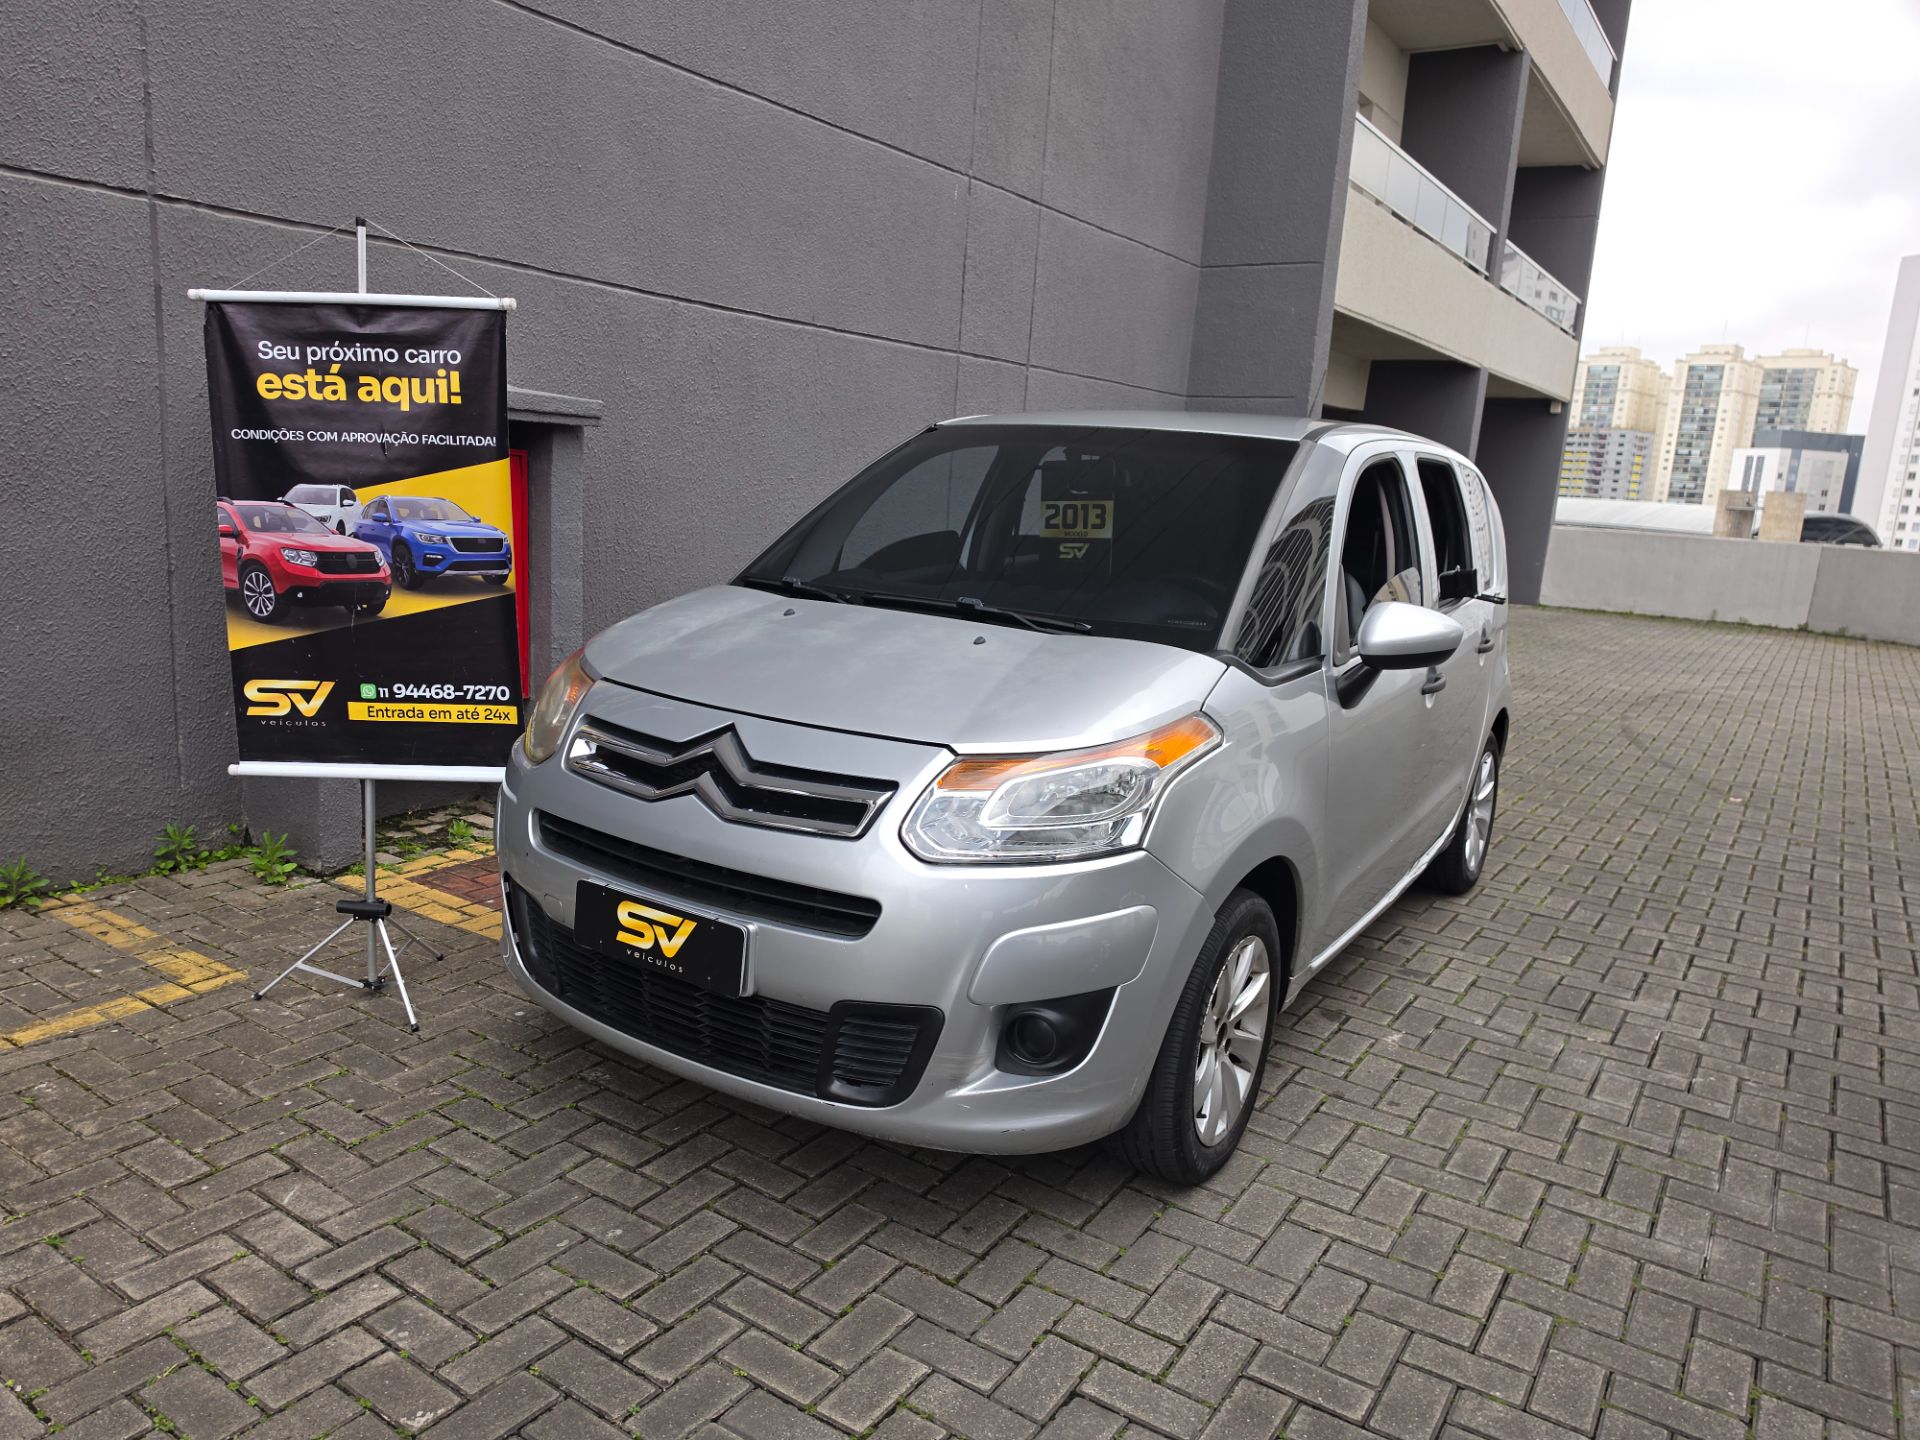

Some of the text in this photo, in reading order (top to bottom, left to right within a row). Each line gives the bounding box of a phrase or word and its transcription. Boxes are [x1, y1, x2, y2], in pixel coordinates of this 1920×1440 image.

[257, 340, 462, 365] Seu próximo carro
[256, 364, 462, 411] está aqui!
[231, 427, 496, 447] CONDIÇÕES COM APROVAÇÃO FACILITADA!
[1044, 503, 1107, 530] 2013
[1059, 543, 1089, 559] SV
[243, 679, 336, 718] SV
[393, 683, 510, 701] 94468-7270
[367, 706, 511, 722] Entrada em até 24x
[616, 900, 698, 958] SV
